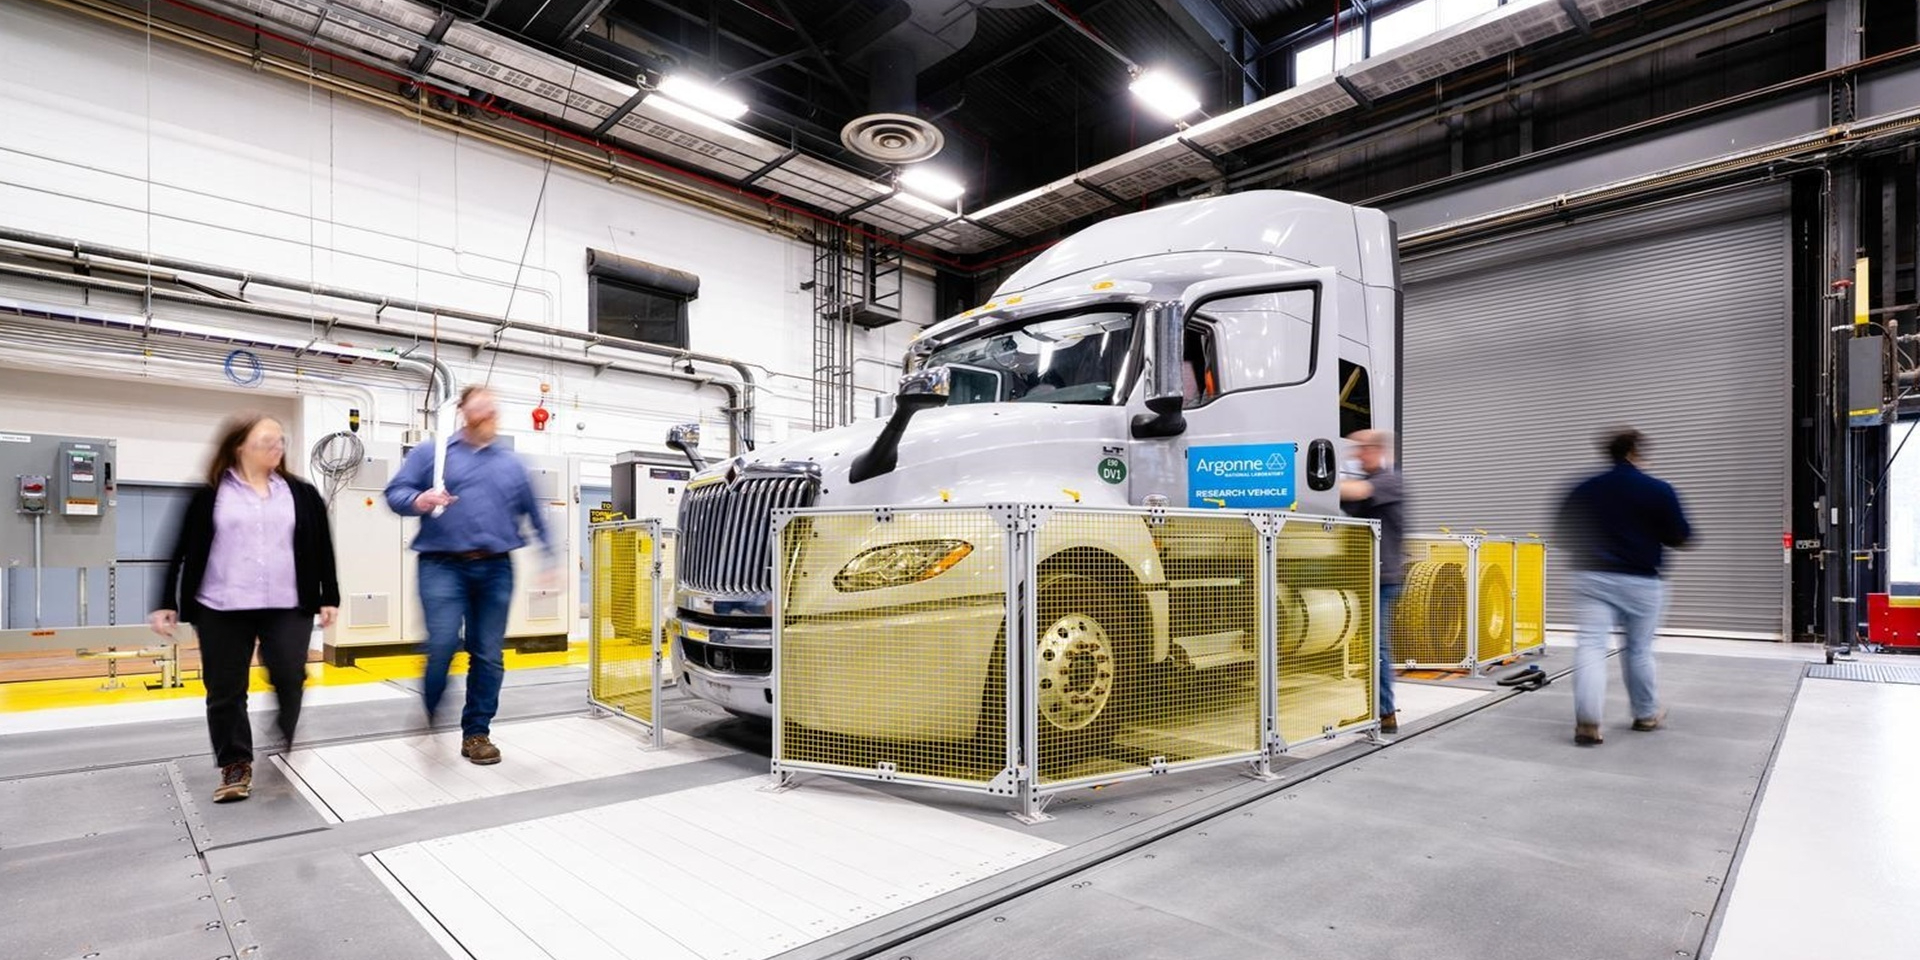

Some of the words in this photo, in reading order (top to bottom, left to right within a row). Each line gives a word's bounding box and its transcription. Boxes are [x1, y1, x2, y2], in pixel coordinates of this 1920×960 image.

[1196, 458, 1264, 476] Argonne
[1103, 468, 1121, 480] DV1
[1196, 488, 1246, 498] RESEARCH
[1247, 487, 1288, 497] VEHICLE
